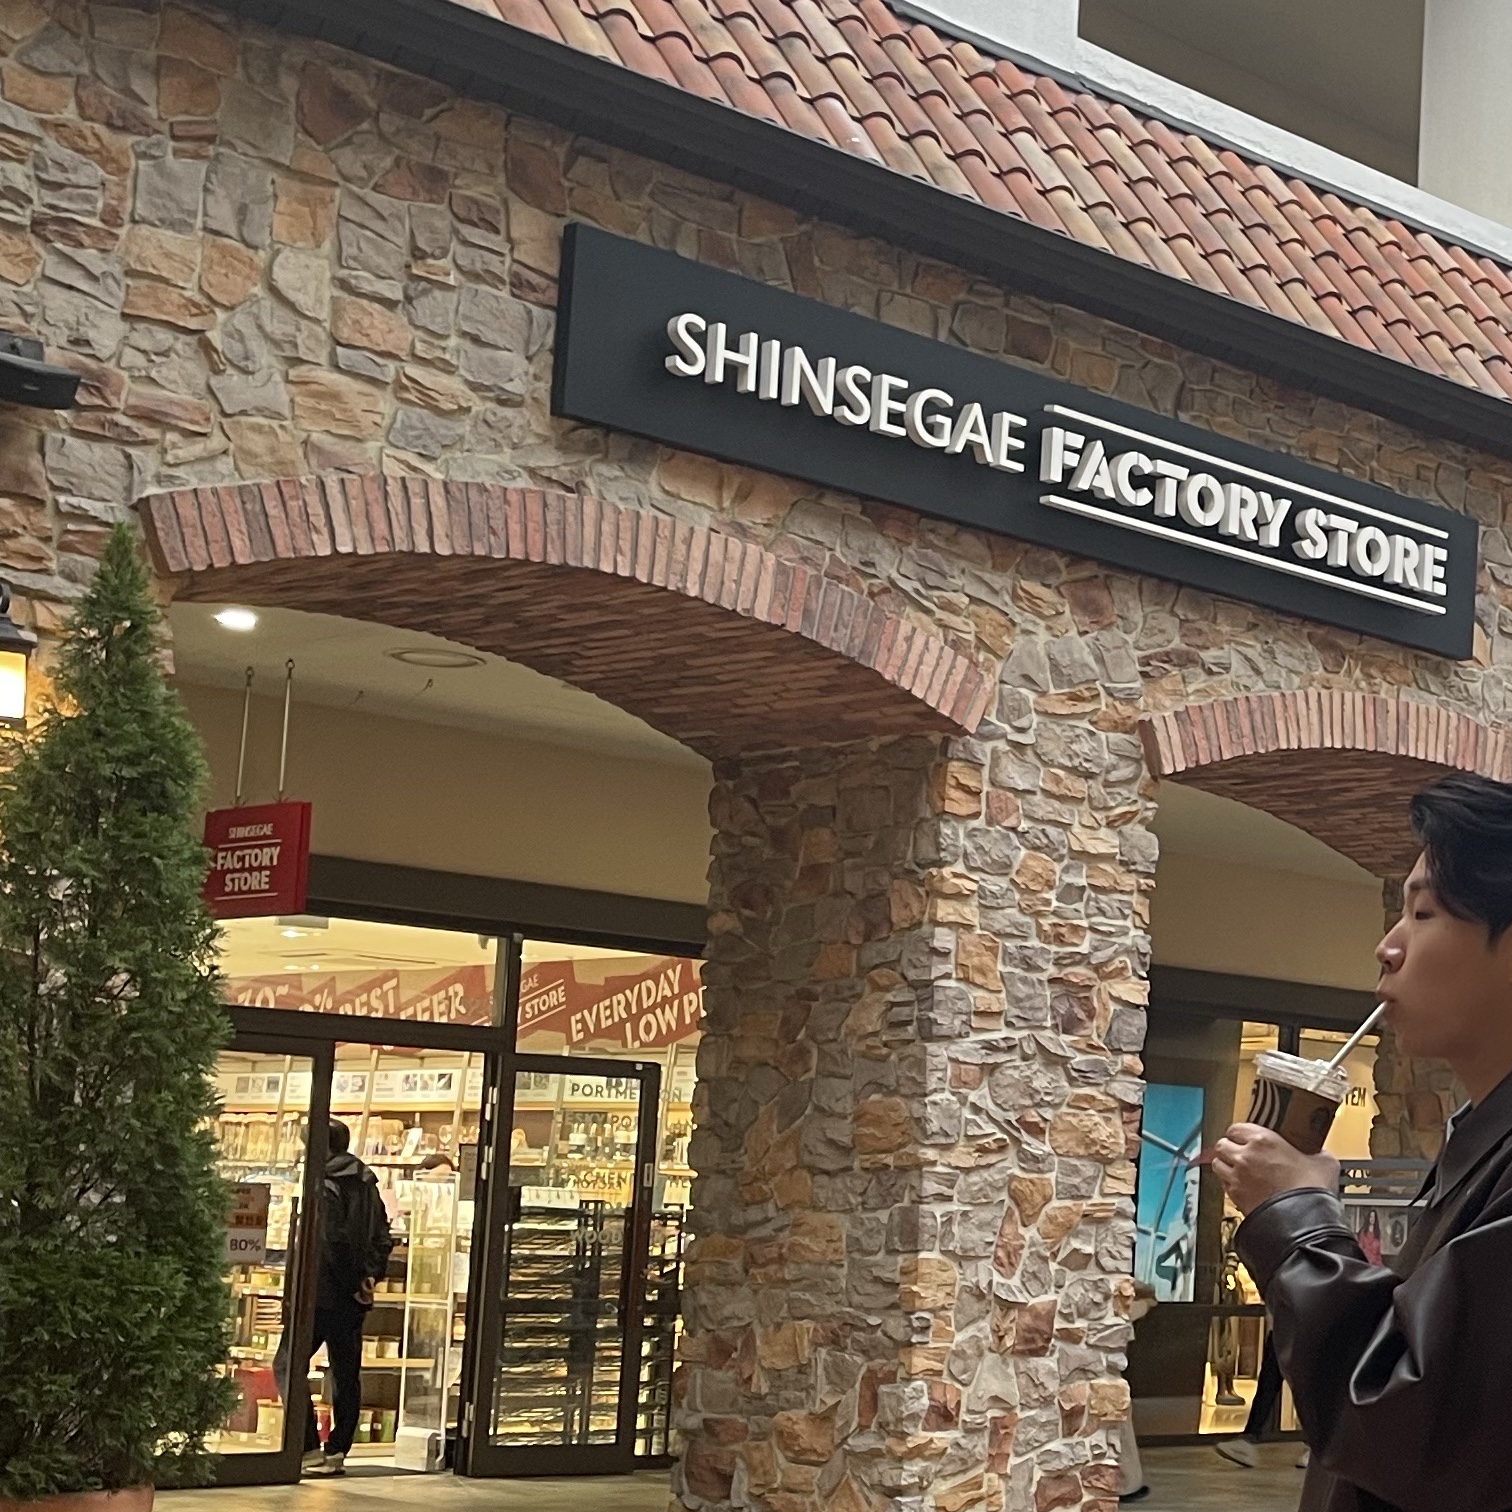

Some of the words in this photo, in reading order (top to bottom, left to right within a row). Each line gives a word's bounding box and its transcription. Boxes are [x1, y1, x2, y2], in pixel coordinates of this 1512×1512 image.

[665, 313, 1027, 473] SHINSEGAE
[1039, 426, 1292, 549] FACTORY
[1291, 507, 1448, 597] STORE
[217, 846, 281, 870] FACTORY
[224, 871, 270, 893] STORE
[524, 985, 567, 1020] STORE
[570, 963, 683, 1042] EVERYDAY
[625, 999, 680, 1049] LOW
